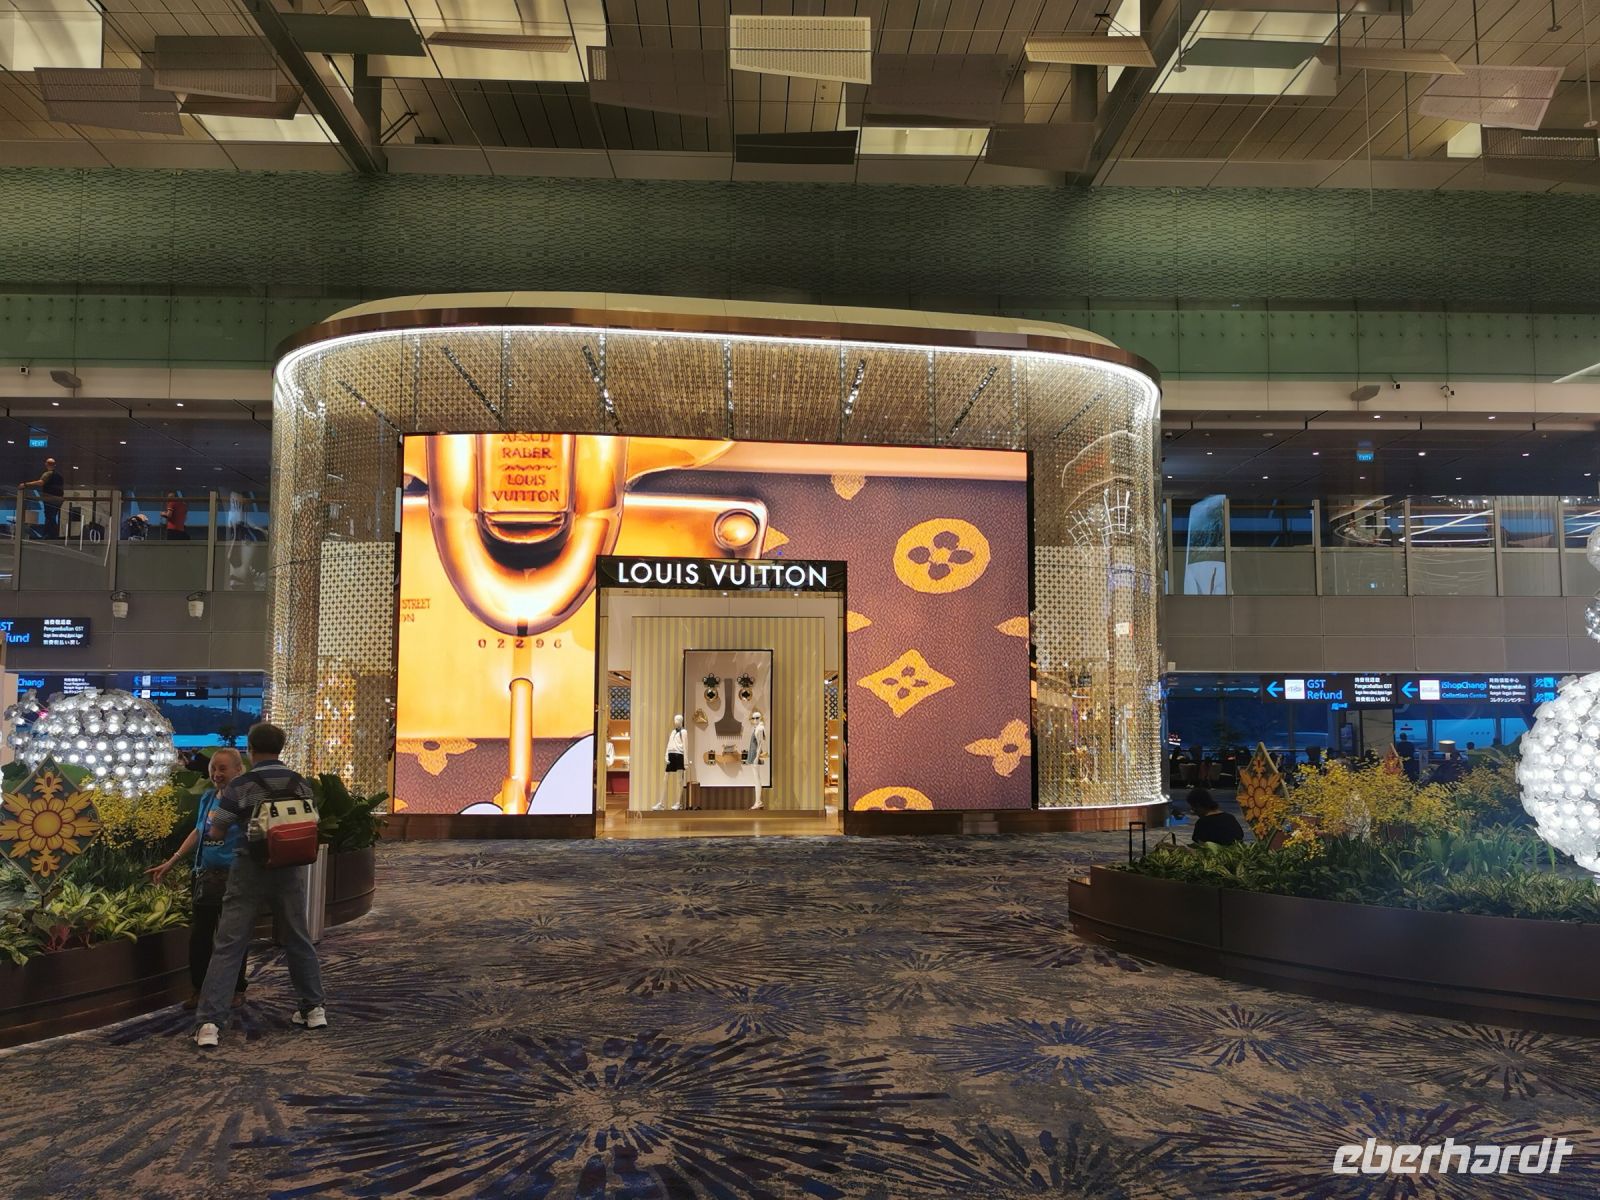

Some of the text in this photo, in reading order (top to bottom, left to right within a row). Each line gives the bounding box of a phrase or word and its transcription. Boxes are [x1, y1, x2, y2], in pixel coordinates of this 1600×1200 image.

[507, 474, 546, 486] LOUIS
[493, 489, 560, 502] VUITTON
[618, 562, 827, 587] LOUIS VUITTON
[402, 598, 431, 610] STREET
[0, 621, 14, 631] ST
[6, 633, 30, 643] fund
[18, 678, 44, 688] Changi
[1307, 679, 1326, 689] GST
[1441, 681, 1487, 690] iShopChangi
[1307, 690, 1343, 700] Refund
